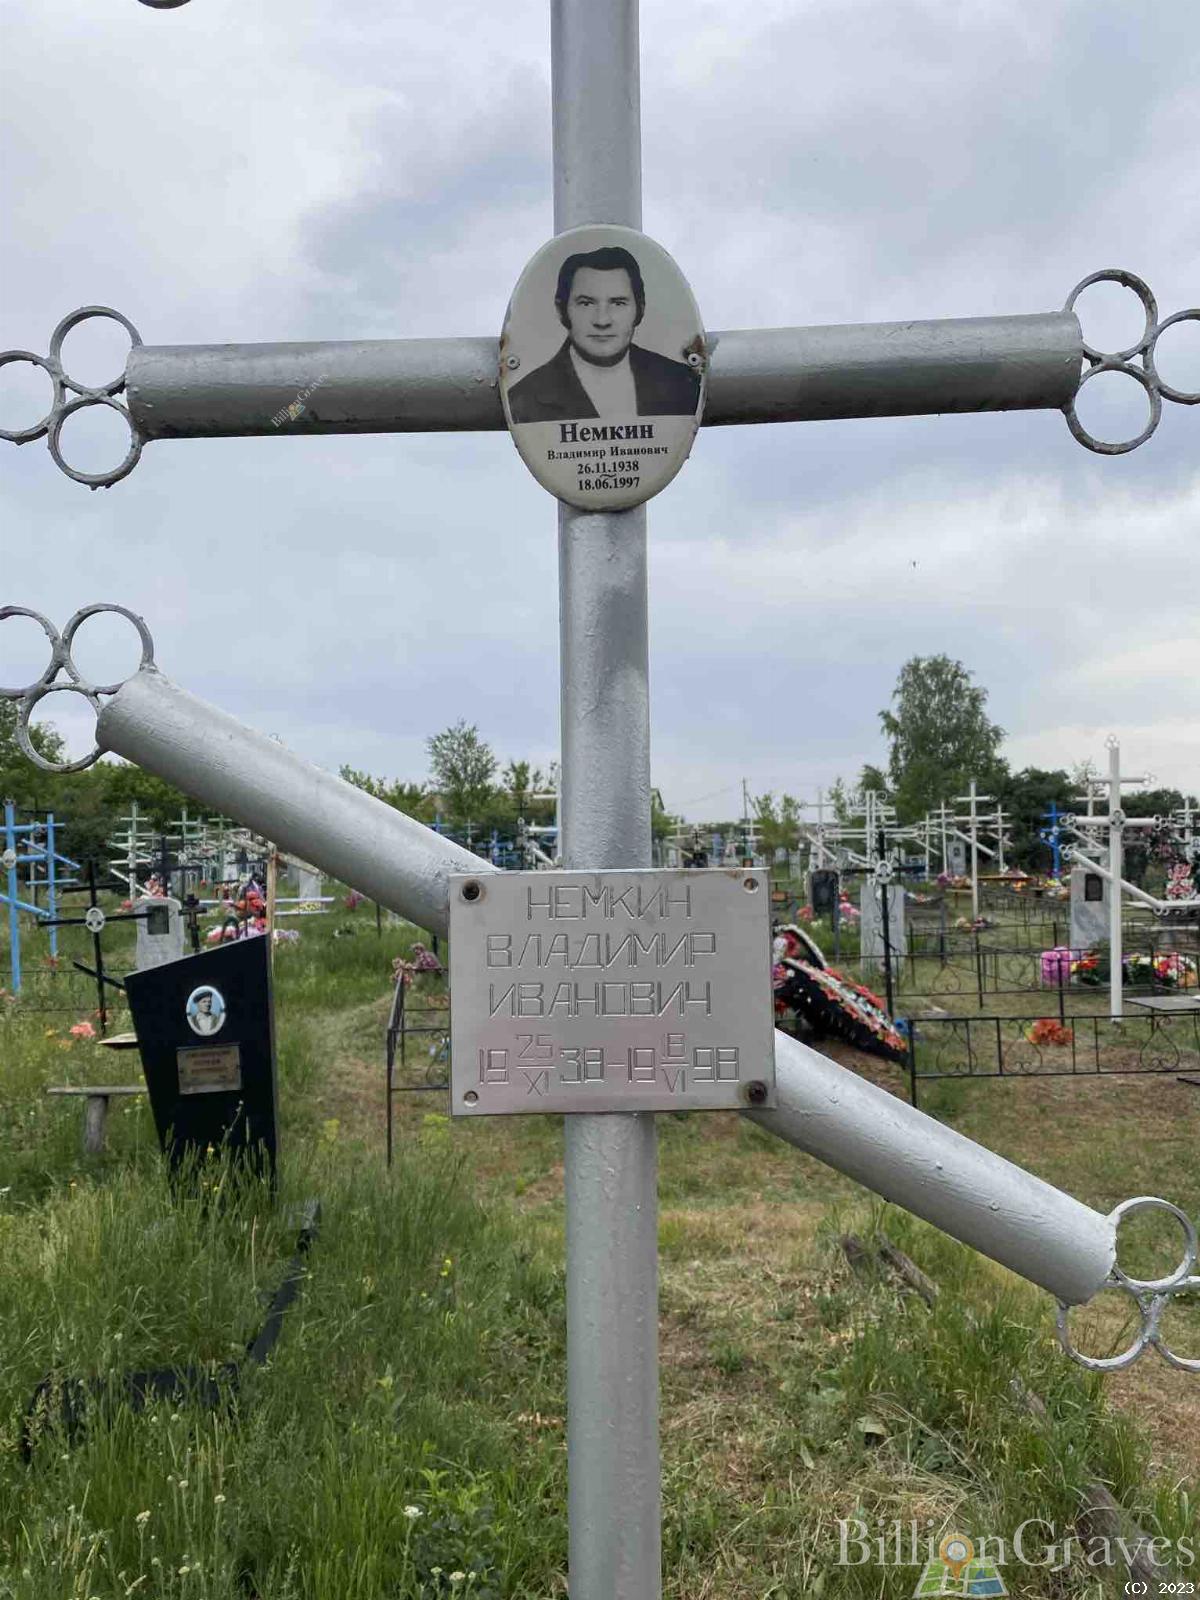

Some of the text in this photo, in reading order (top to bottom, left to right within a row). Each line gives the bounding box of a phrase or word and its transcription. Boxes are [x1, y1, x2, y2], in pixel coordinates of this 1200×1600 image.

[559, 421, 655, 443] Немкин
[547, 445, 669, 460] Владимир Иванович
[577, 460, 640, 475] 26.11.1938
[578, 476, 640, 491] 18.06.1997
[527, 885, 691, 920] НЕМКИН
[486, 931, 716, 972] ВЛАДИМИР
[488, 981, 712, 1018] ИВАНОВИЧ
